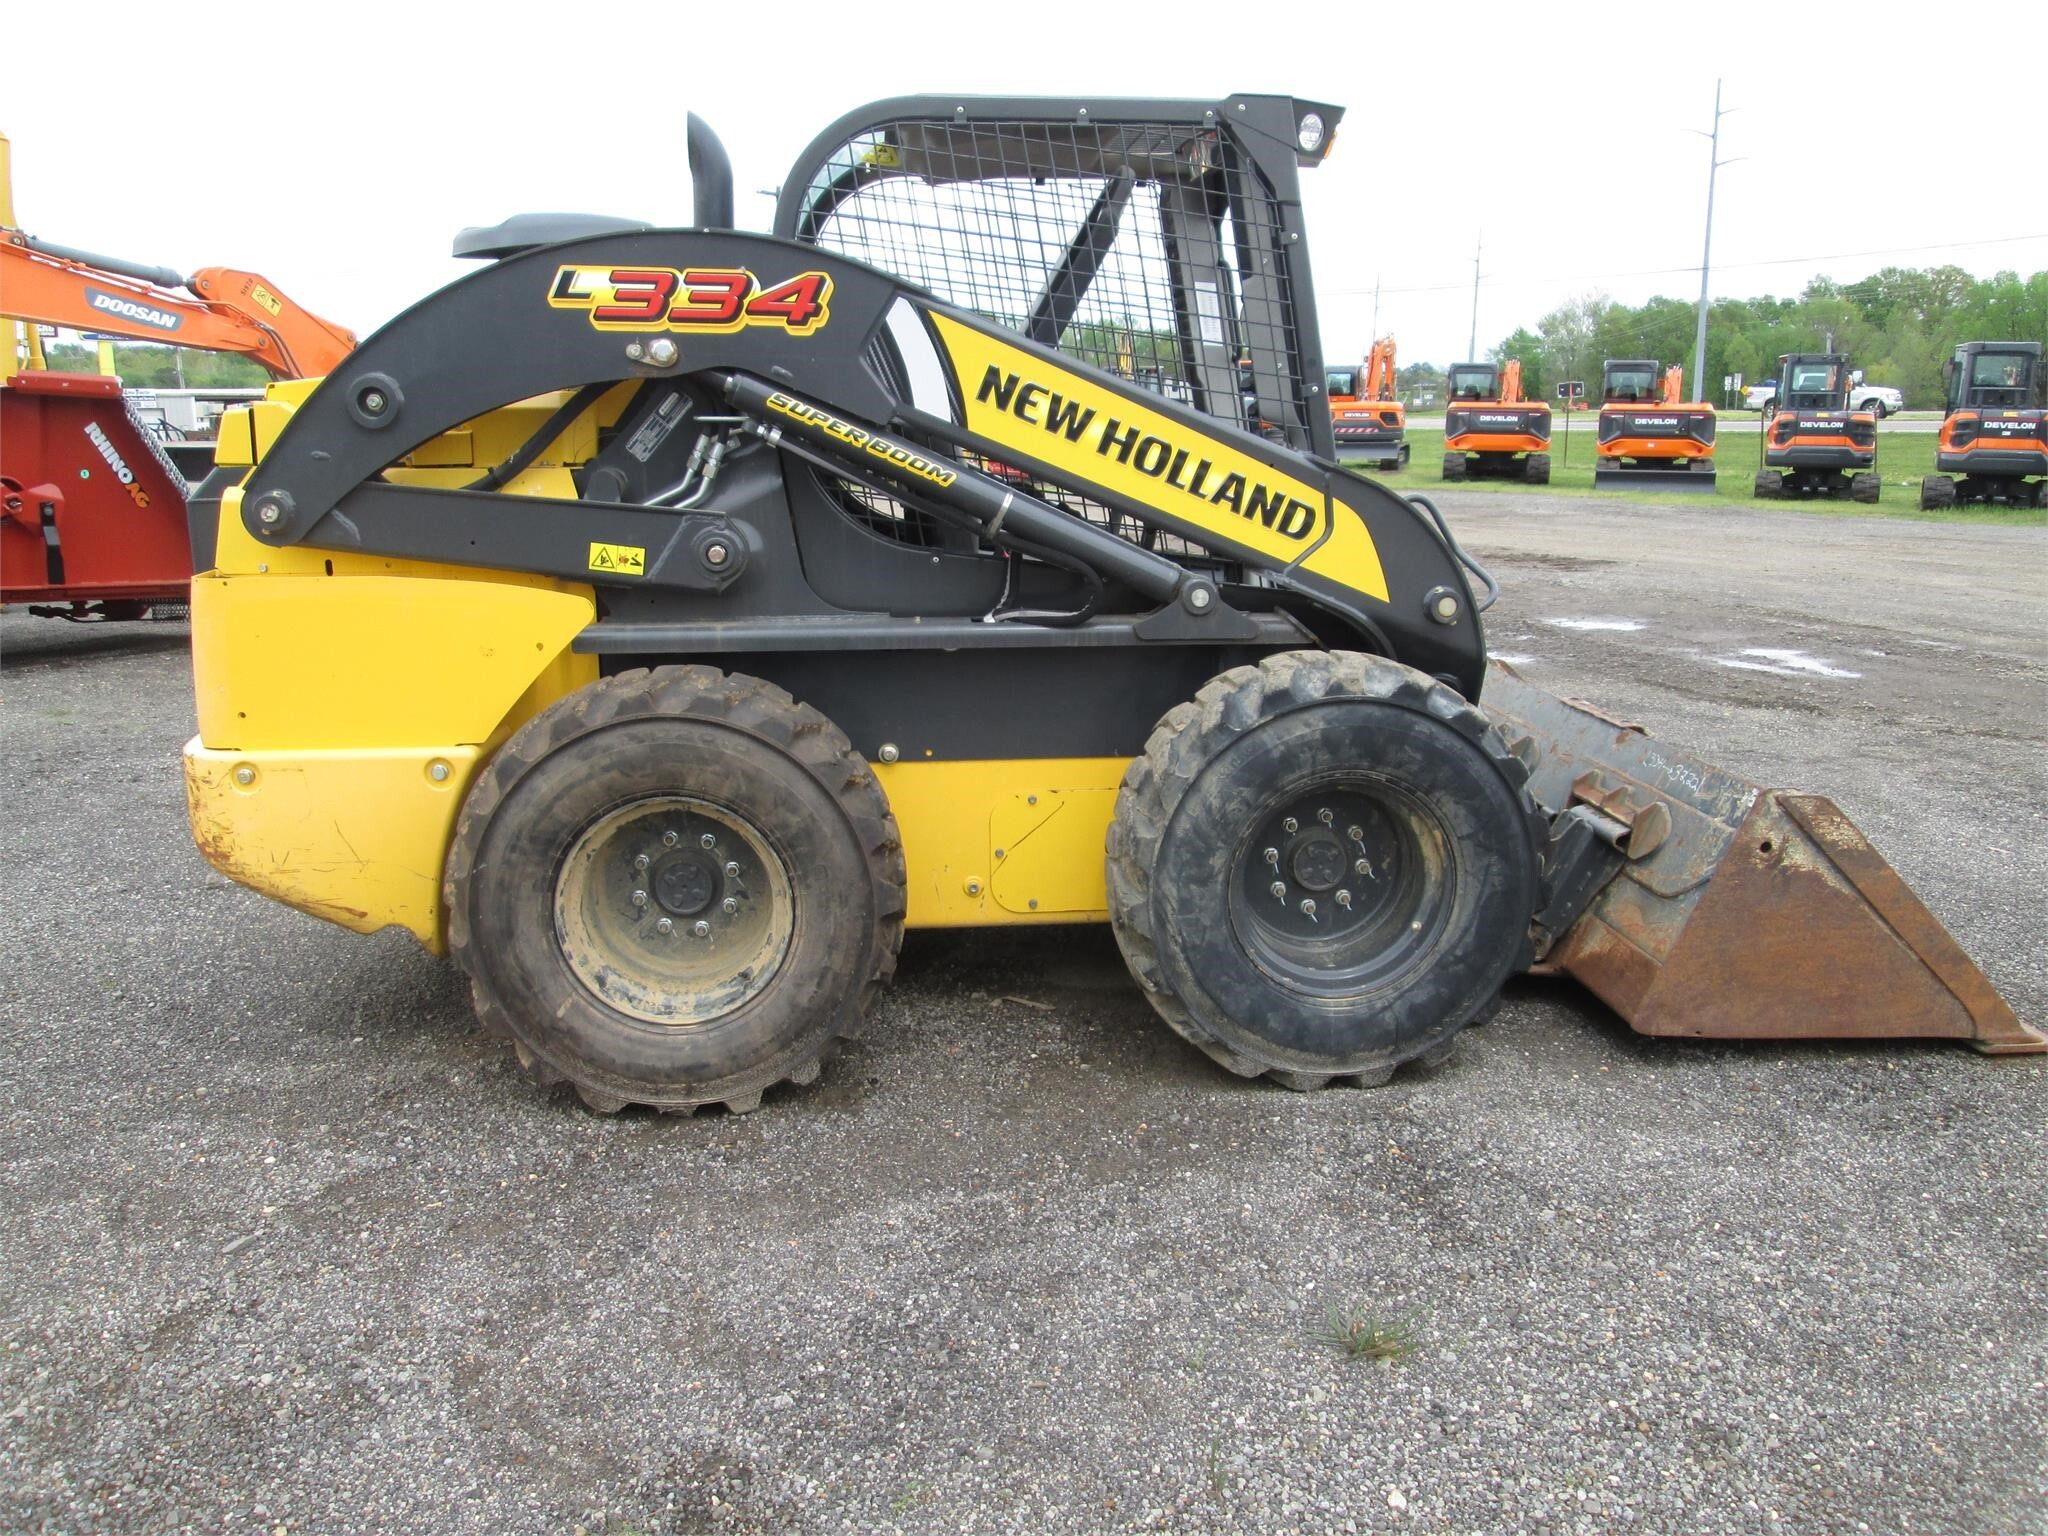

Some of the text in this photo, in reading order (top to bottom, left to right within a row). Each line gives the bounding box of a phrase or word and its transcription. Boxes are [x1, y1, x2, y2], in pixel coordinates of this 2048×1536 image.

[93, 294, 177, 328] DOOSAN
[549, 265, 832, 335] L334
[767, 392, 957, 488] SUPER BOOM
[976, 364, 1316, 541] NEW HOLLAND
[1983, 421, 2037, 430] DEVELON
